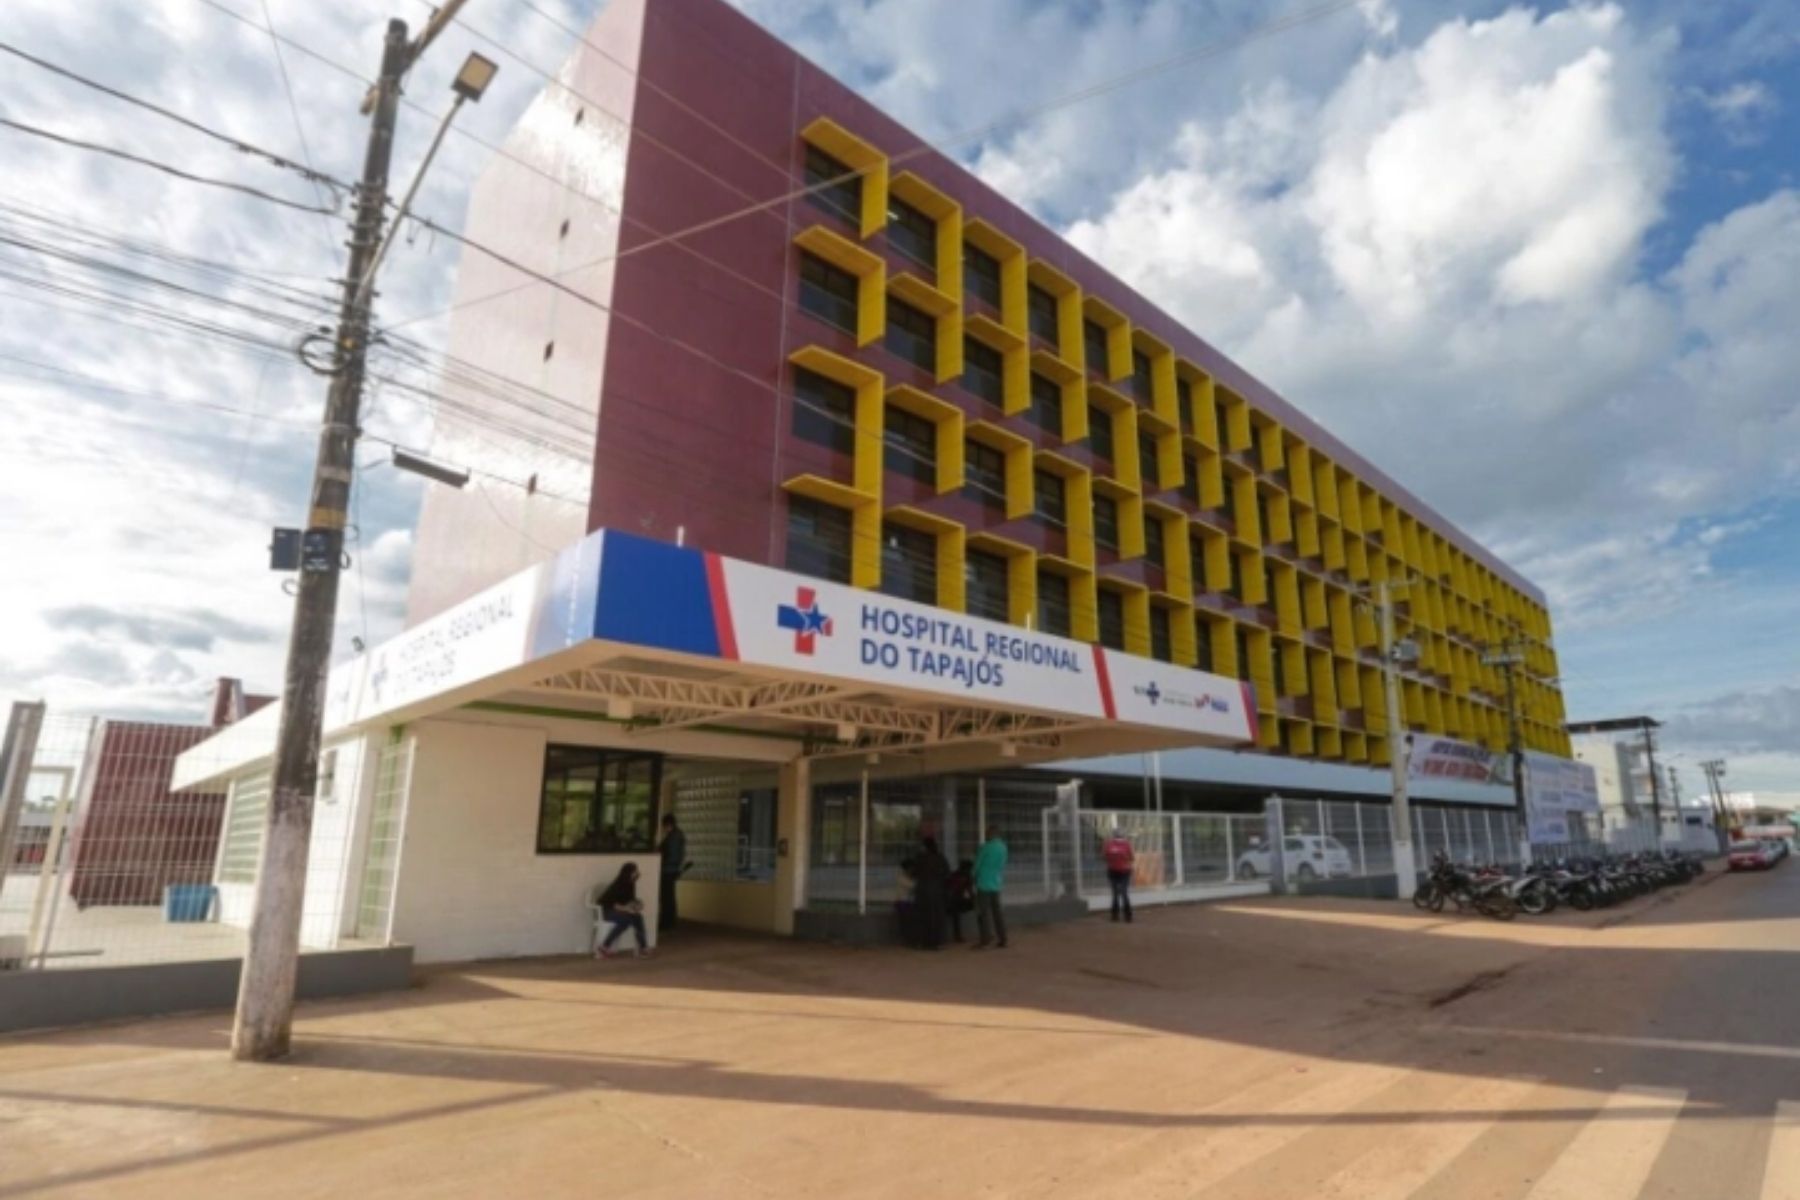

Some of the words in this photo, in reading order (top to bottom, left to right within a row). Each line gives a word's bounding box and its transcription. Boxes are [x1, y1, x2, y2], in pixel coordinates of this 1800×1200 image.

[860, 604, 979, 652] HOSPITAL
[985, 632, 1081, 673] REGIONAL
[860, 637, 900, 670] DO
[907, 645, 1005, 688] TAPAJÓS
